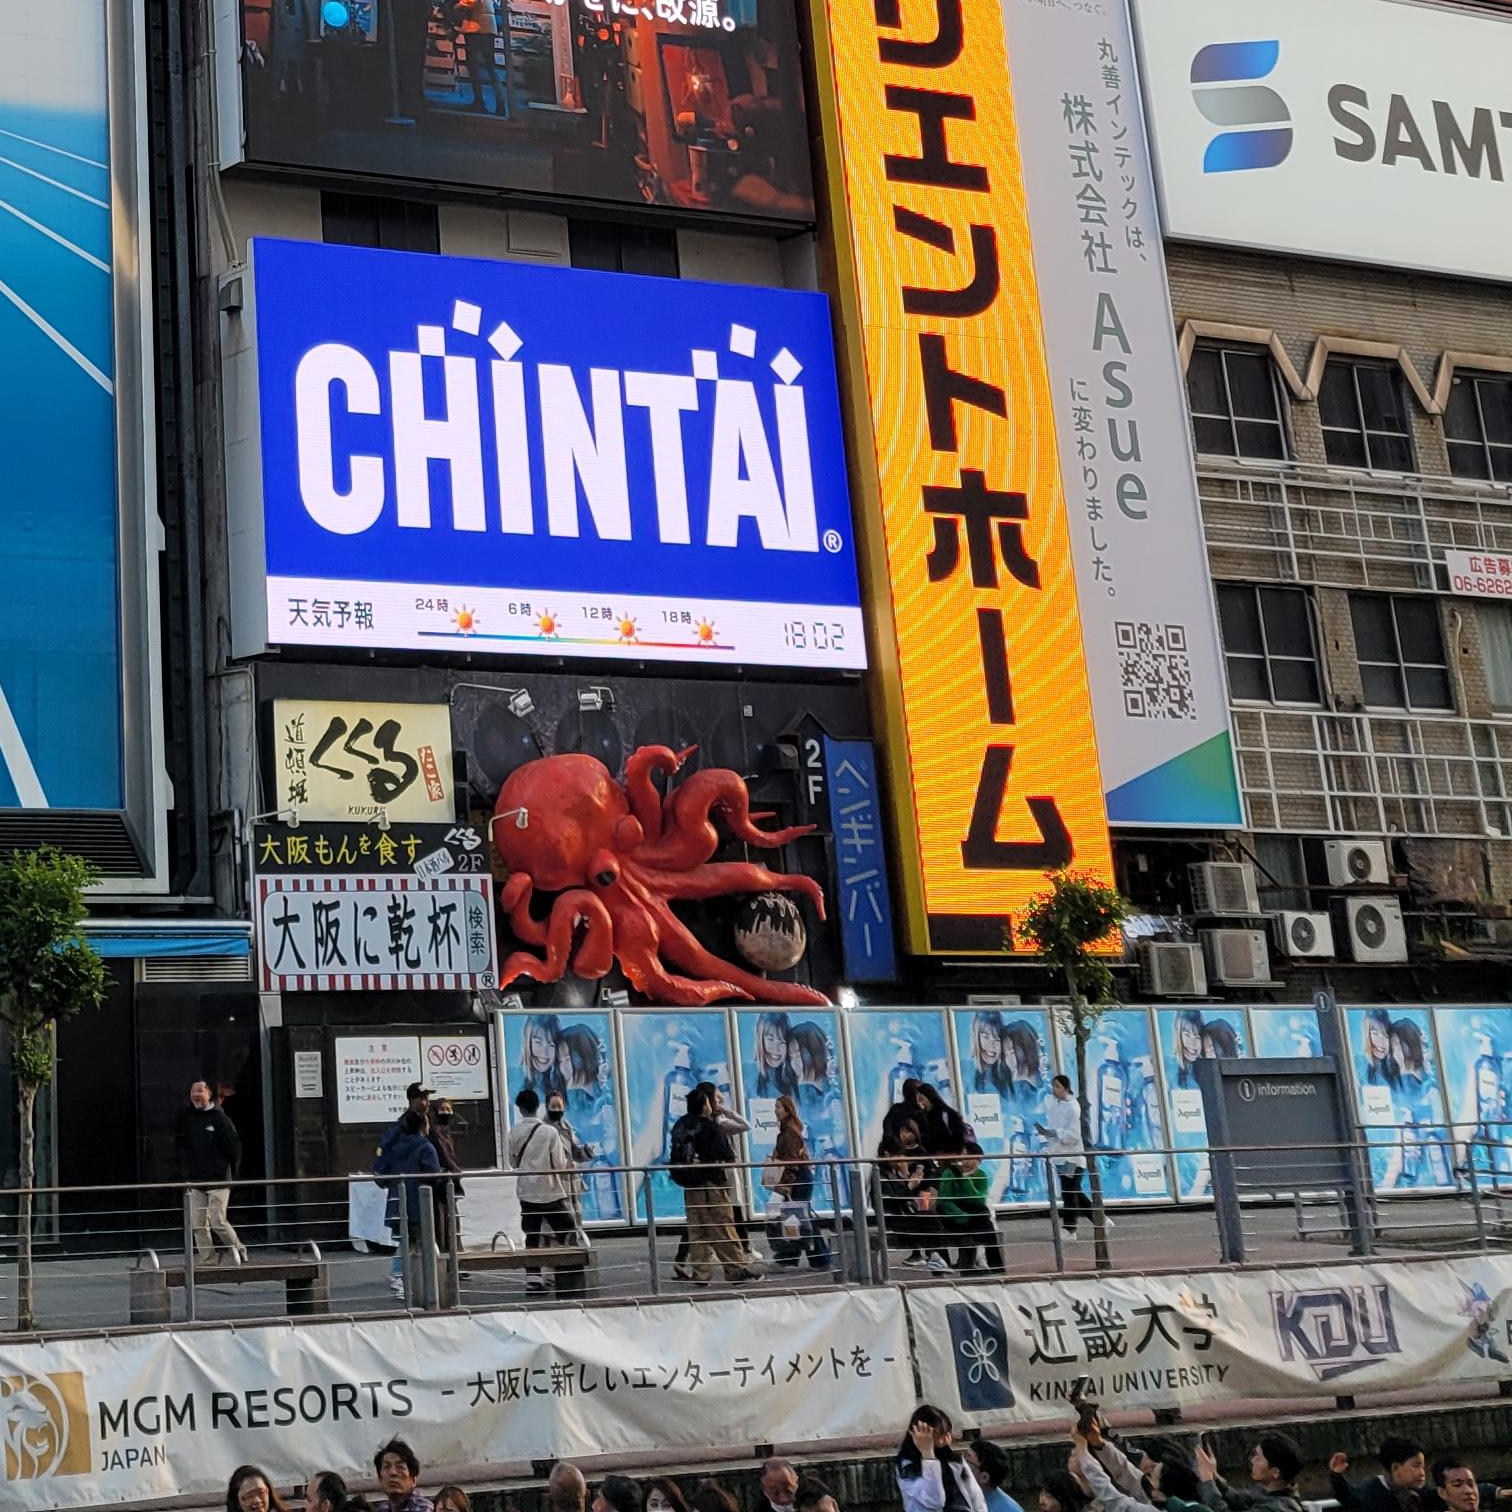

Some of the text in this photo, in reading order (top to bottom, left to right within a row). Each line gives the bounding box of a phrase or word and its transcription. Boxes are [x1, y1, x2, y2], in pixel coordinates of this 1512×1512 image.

[1097, 38, 1148, 262] 丸善インテックは、
[1060, 91, 1149, 521] 株式会社 Asue
[295, 299, 820, 553] CHINTAI
[1069, 377, 1117, 598] に変わりました。
[288, 597, 375, 632] 天気予報
[415, 596, 449, 615] 24時
[508, 601, 532, 618] 6時
[581, 604, 613, 622] 12時
[661, 608, 692, 626] 18時
[284, 713, 309, 806] 道頓堀
[309, 716, 419, 804] くくる
[259, 832, 423, 866] 大阪もんを食す
[444, 827, 481, 850] くくる
[457, 853, 485, 872] 2F
[835, 759, 884, 957] ペンギンバー
[272, 893, 462, 971] 大阪に乾杯
[468, 905, 486, 955] 検索
[1257, 1082, 1317, 1096] information
[1018, 1293, 1219, 1366] 近畿大学
[98, 1378, 414, 1441] MGM RESORTS
[1113, 1364, 1229, 1395] UNIVERSITY
[101, 1443, 167, 1472] JAPAN
